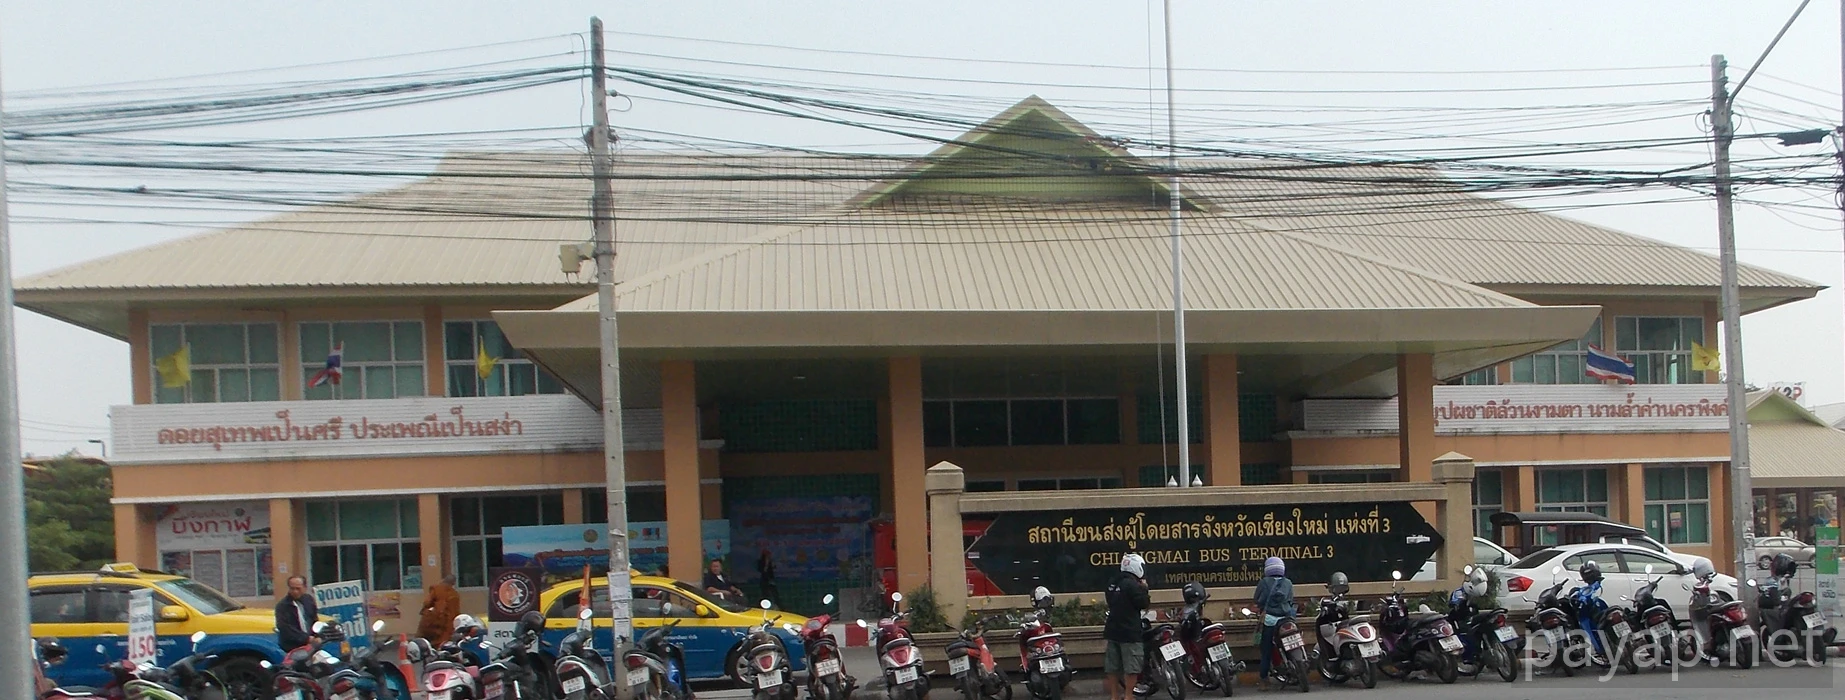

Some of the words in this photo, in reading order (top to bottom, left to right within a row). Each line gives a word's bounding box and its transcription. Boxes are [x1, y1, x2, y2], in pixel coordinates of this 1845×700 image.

[157, 409, 343, 451] ดอยสุเทพเป็นศรี
[350, 405, 523, 439] ประเพณีเป็นสง่า
[1028, 508, 1328, 549] สถานีขนส่งผู้โดยสารจังหวัดเชียงใหม่
[1335, 505, 1379, 535] แห่งที่
[1383, 522, 1391, 533] 3
[1090, 550, 1190, 566] CHIGMAI
[1200, 549, 1230, 562] BUS
[1239, 547, 1322, 562] TERMINAL
[1327, 546, 1334, 558] 3
[317, 584, 360, 606] จุดจอด
[131, 634, 155, 659] 150
